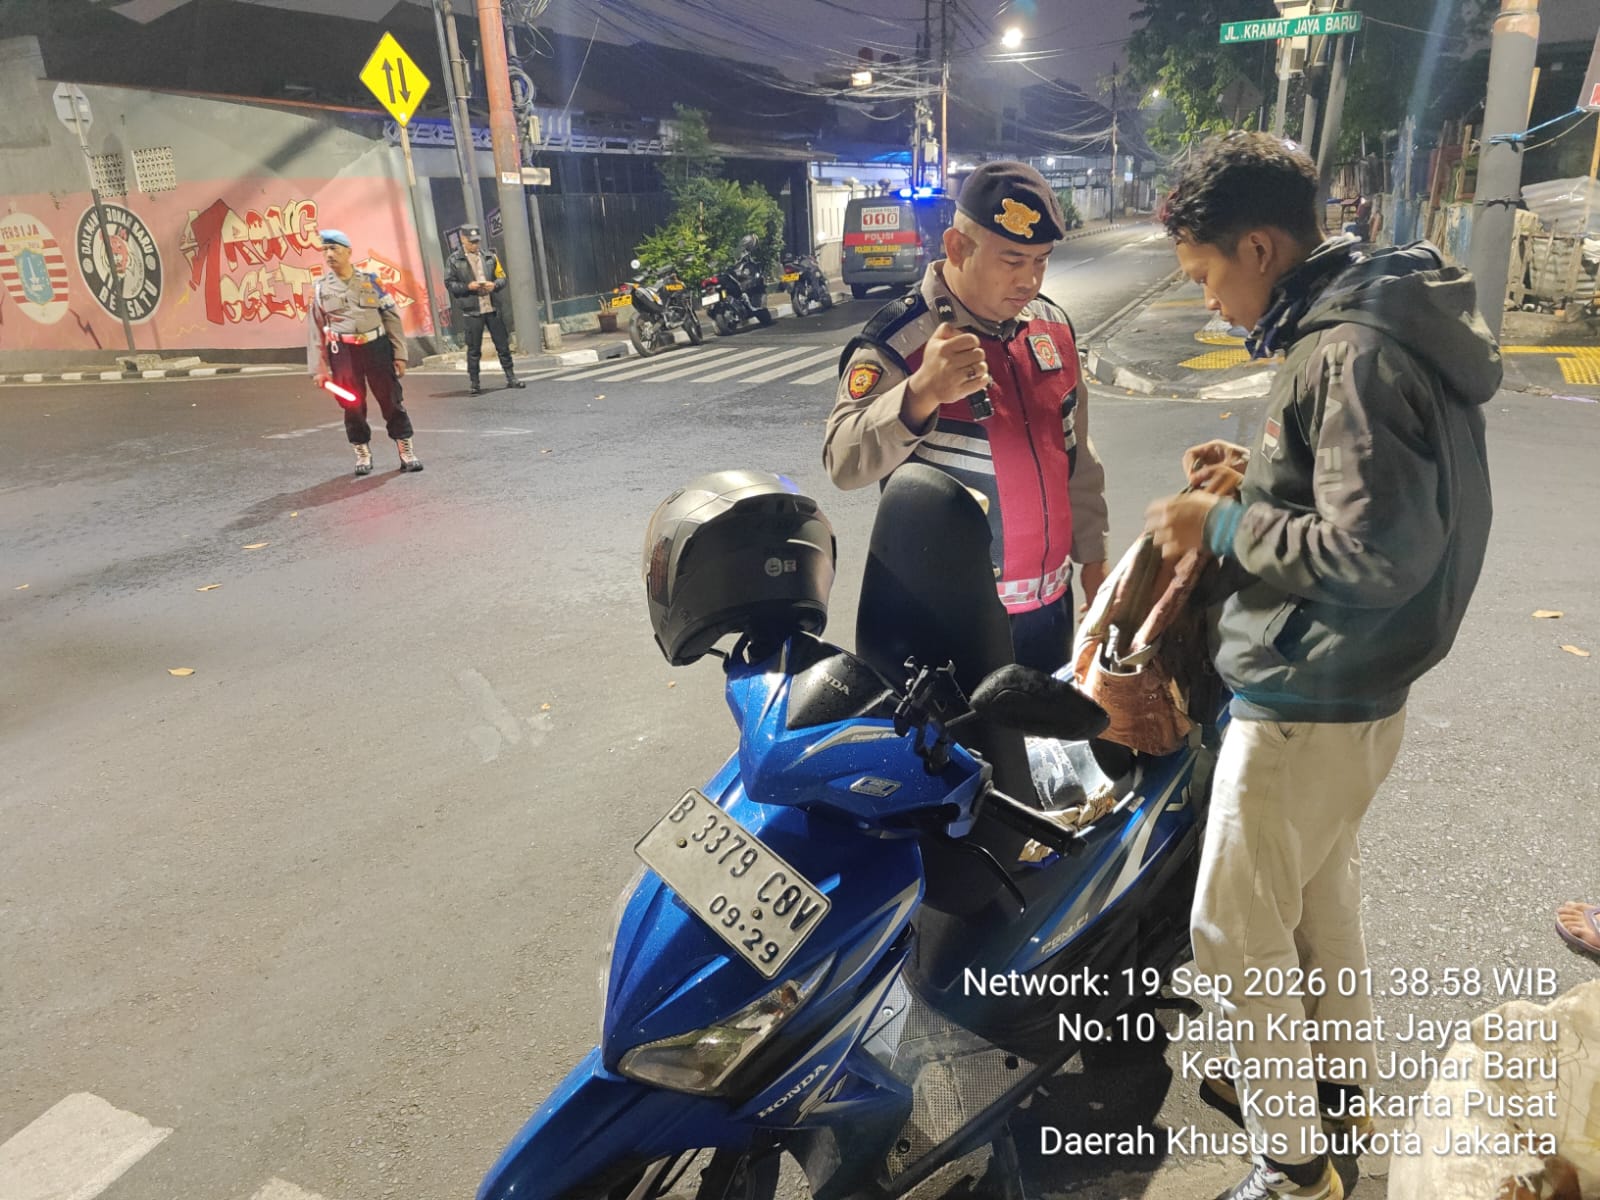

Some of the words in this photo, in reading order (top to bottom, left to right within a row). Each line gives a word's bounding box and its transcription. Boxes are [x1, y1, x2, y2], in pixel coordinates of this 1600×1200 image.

[1224, 26, 1239, 41] JL.
[1243, 21, 1290, 39] KRAMAT
[1294, 16, 1320, 35] JAYA
[1325, 14, 1357, 32] BARU
[863, 213, 898, 225] 110
[864, 232, 894, 241] POLISI
[98, 279, 158, 318] BESATU
[669, 795, 696, 823] B
[692, 815, 758, 878] 3379
[757, 1064, 829, 1119] HONDA
